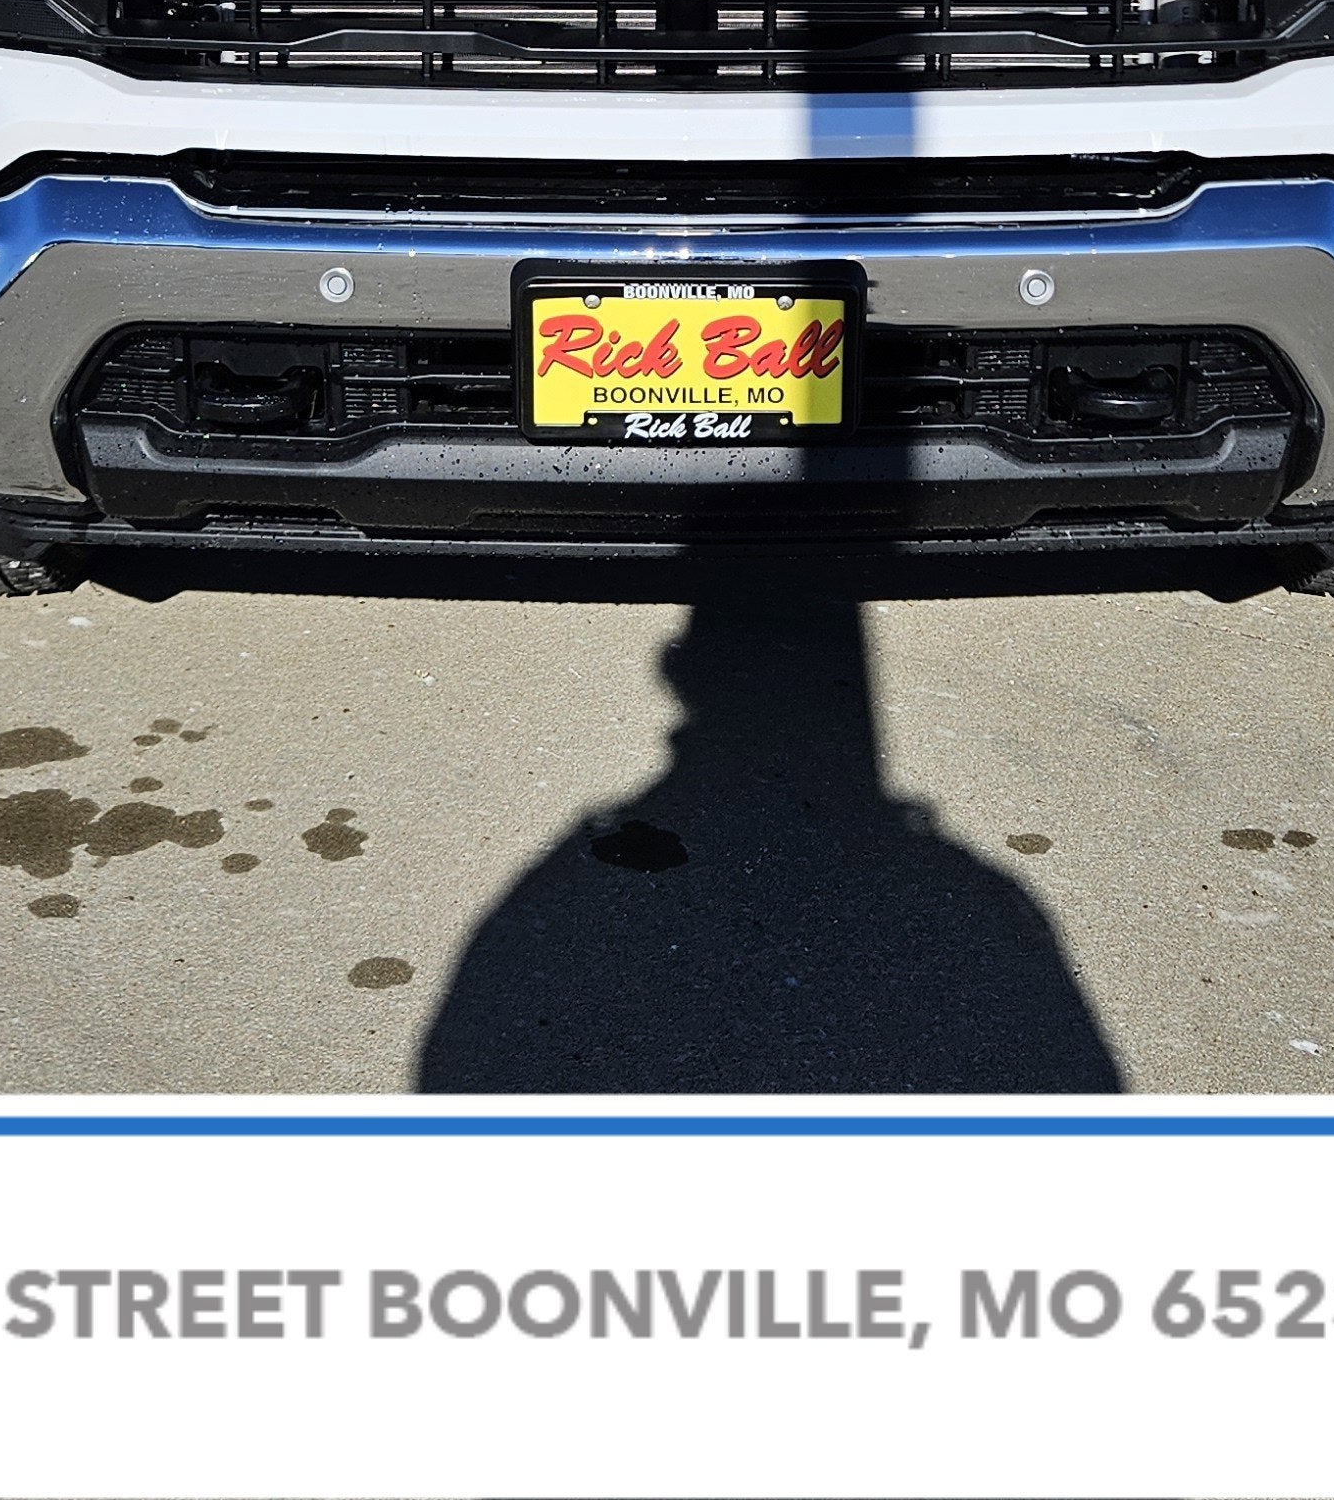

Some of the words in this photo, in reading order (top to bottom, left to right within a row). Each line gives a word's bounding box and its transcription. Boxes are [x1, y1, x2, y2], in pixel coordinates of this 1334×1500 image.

[623, 284, 721, 302] BOONVILLE,
[727, 284, 755, 300] MO
[537, 314, 684, 379] Rick
[701, 314, 845, 380] Ball
[593, 386, 739, 407] BOONVILLE,
[747, 386, 785, 404] MO
[624, 412, 687, 440] Rick
[693, 412, 752, 439] Ball
